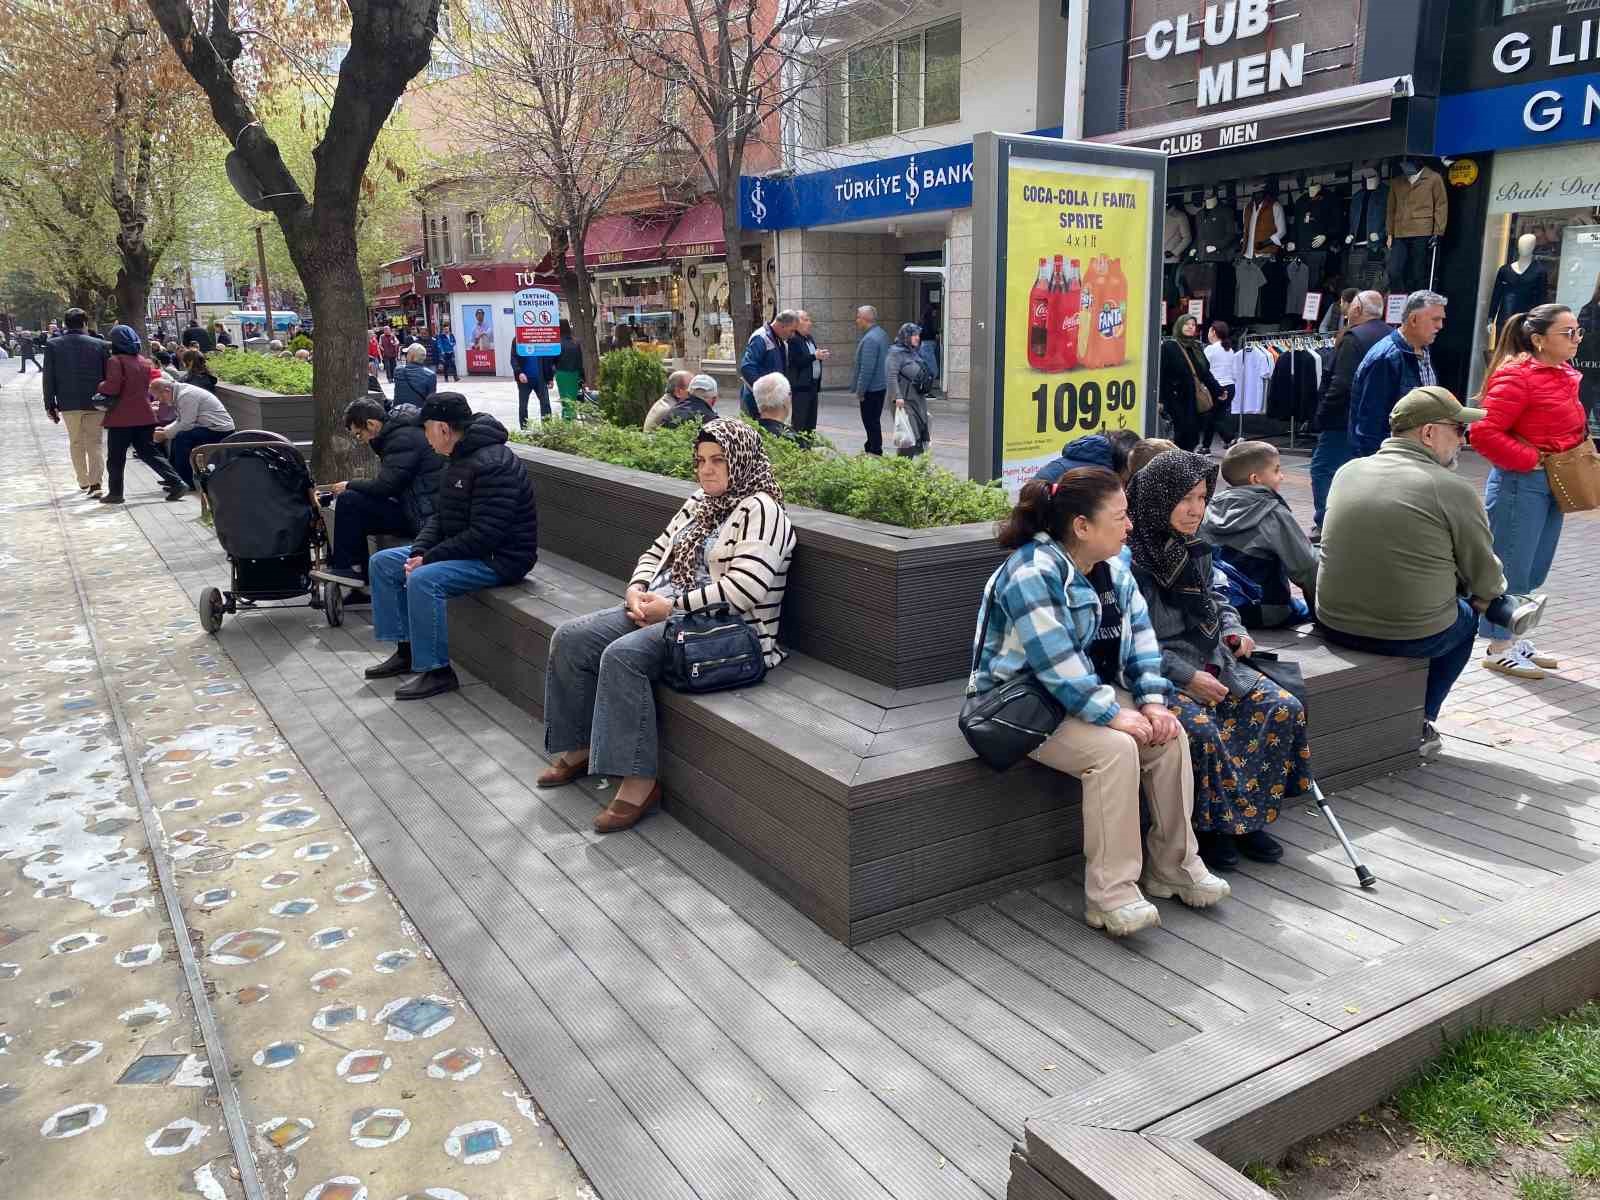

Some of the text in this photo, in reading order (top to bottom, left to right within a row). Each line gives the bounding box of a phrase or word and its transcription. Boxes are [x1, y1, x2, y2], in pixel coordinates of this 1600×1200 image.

[1144, 0, 1269, 61] CLUB
[1492, 31, 1531, 73] G
[1196, 42, 1305, 108] MEN
[1523, 90, 1563, 132] G
[1159, 122, 1259, 154] CLUB MEN
[834, 173, 901, 201] TÜRKİYE
[1023, 184, 1089, 207] COCA-COLA
[1102, 191, 1136, 209] FANTA
[1496, 181, 1553, 201] Baki
[1059, 211, 1103, 230] SPRITE
[1066, 233, 1072, 247] 4
